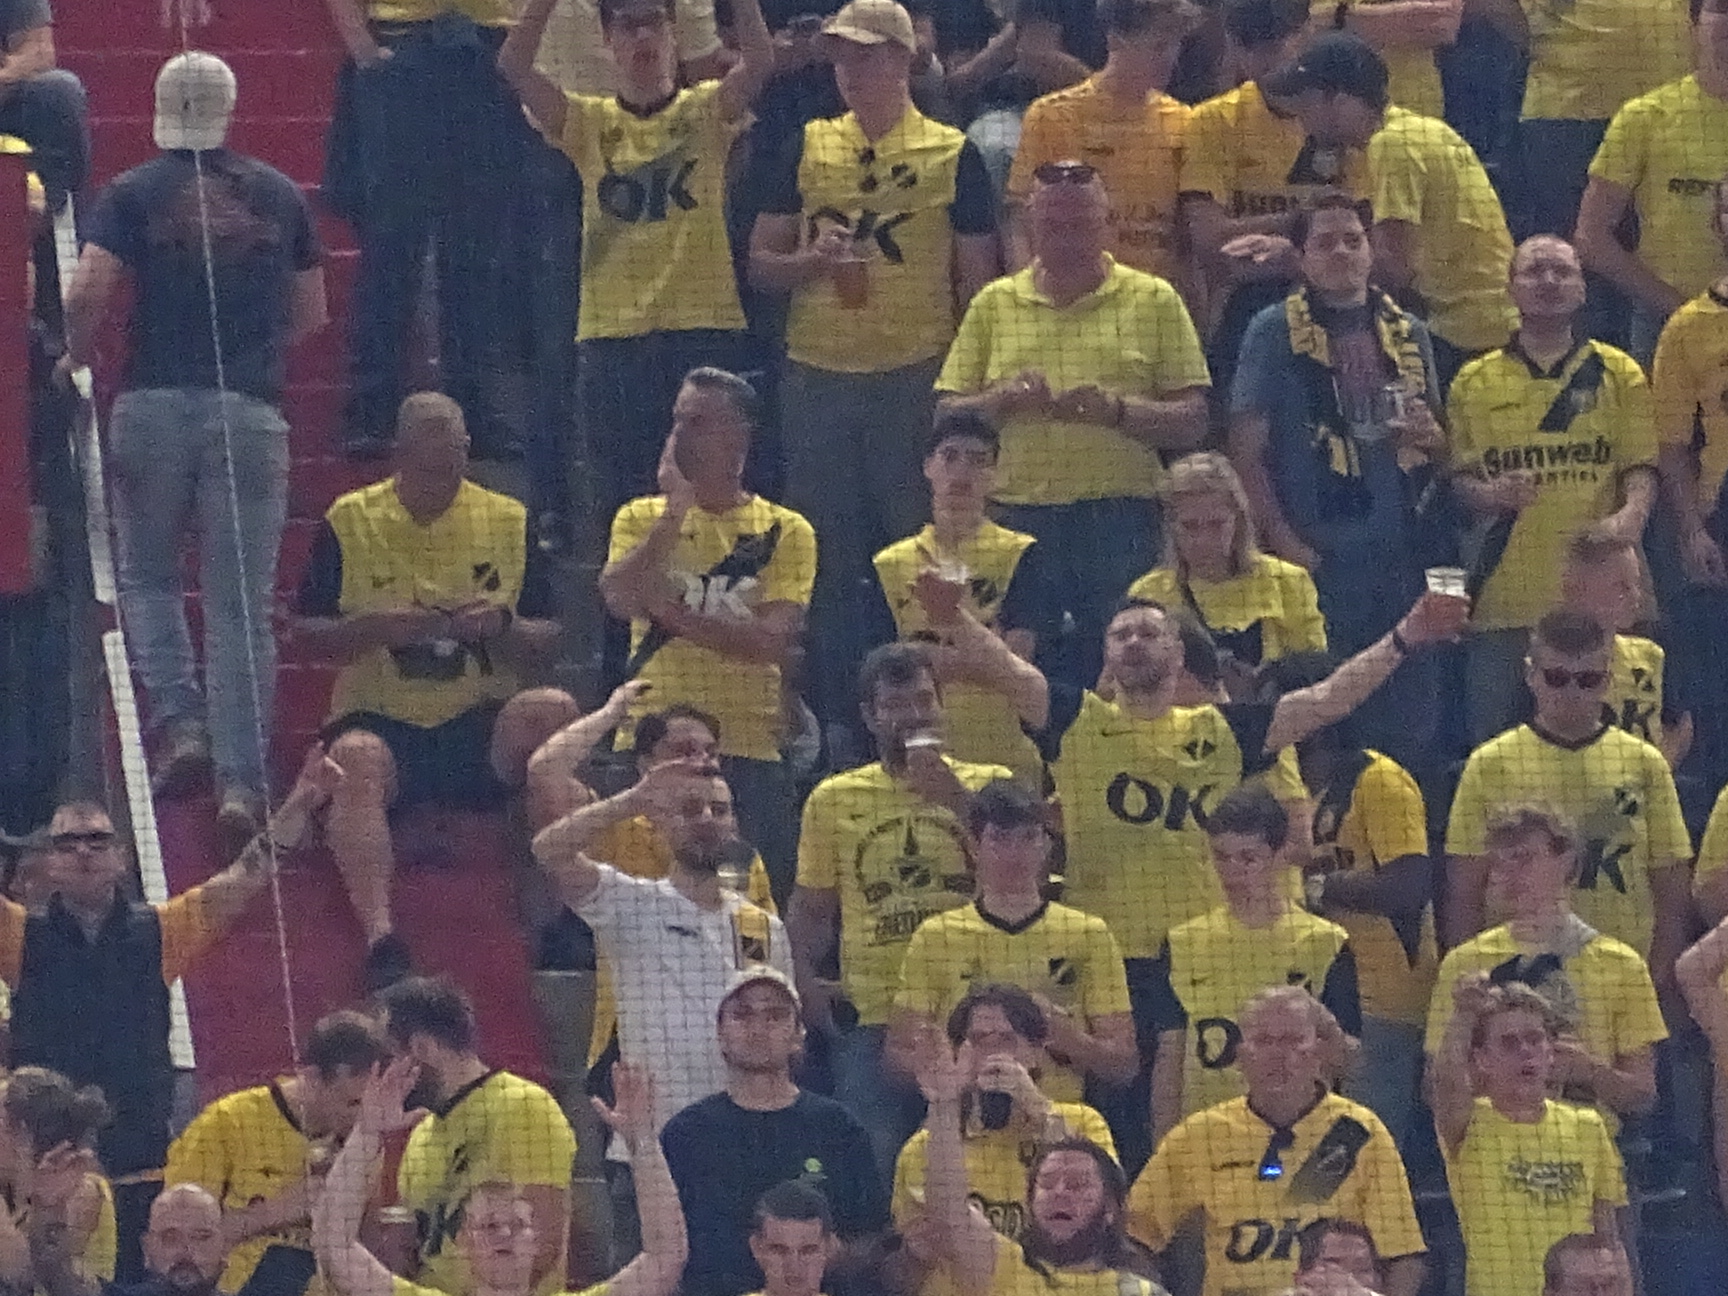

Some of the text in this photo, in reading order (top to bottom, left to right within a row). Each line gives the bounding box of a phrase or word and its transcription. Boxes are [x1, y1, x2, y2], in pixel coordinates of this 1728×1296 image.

[598, 157, 700, 223] OK
[1483, 436, 1612, 471] sunweb
[1106, 770, 1210, 832] OK
[1194, 1018, 1242, 1069] O
